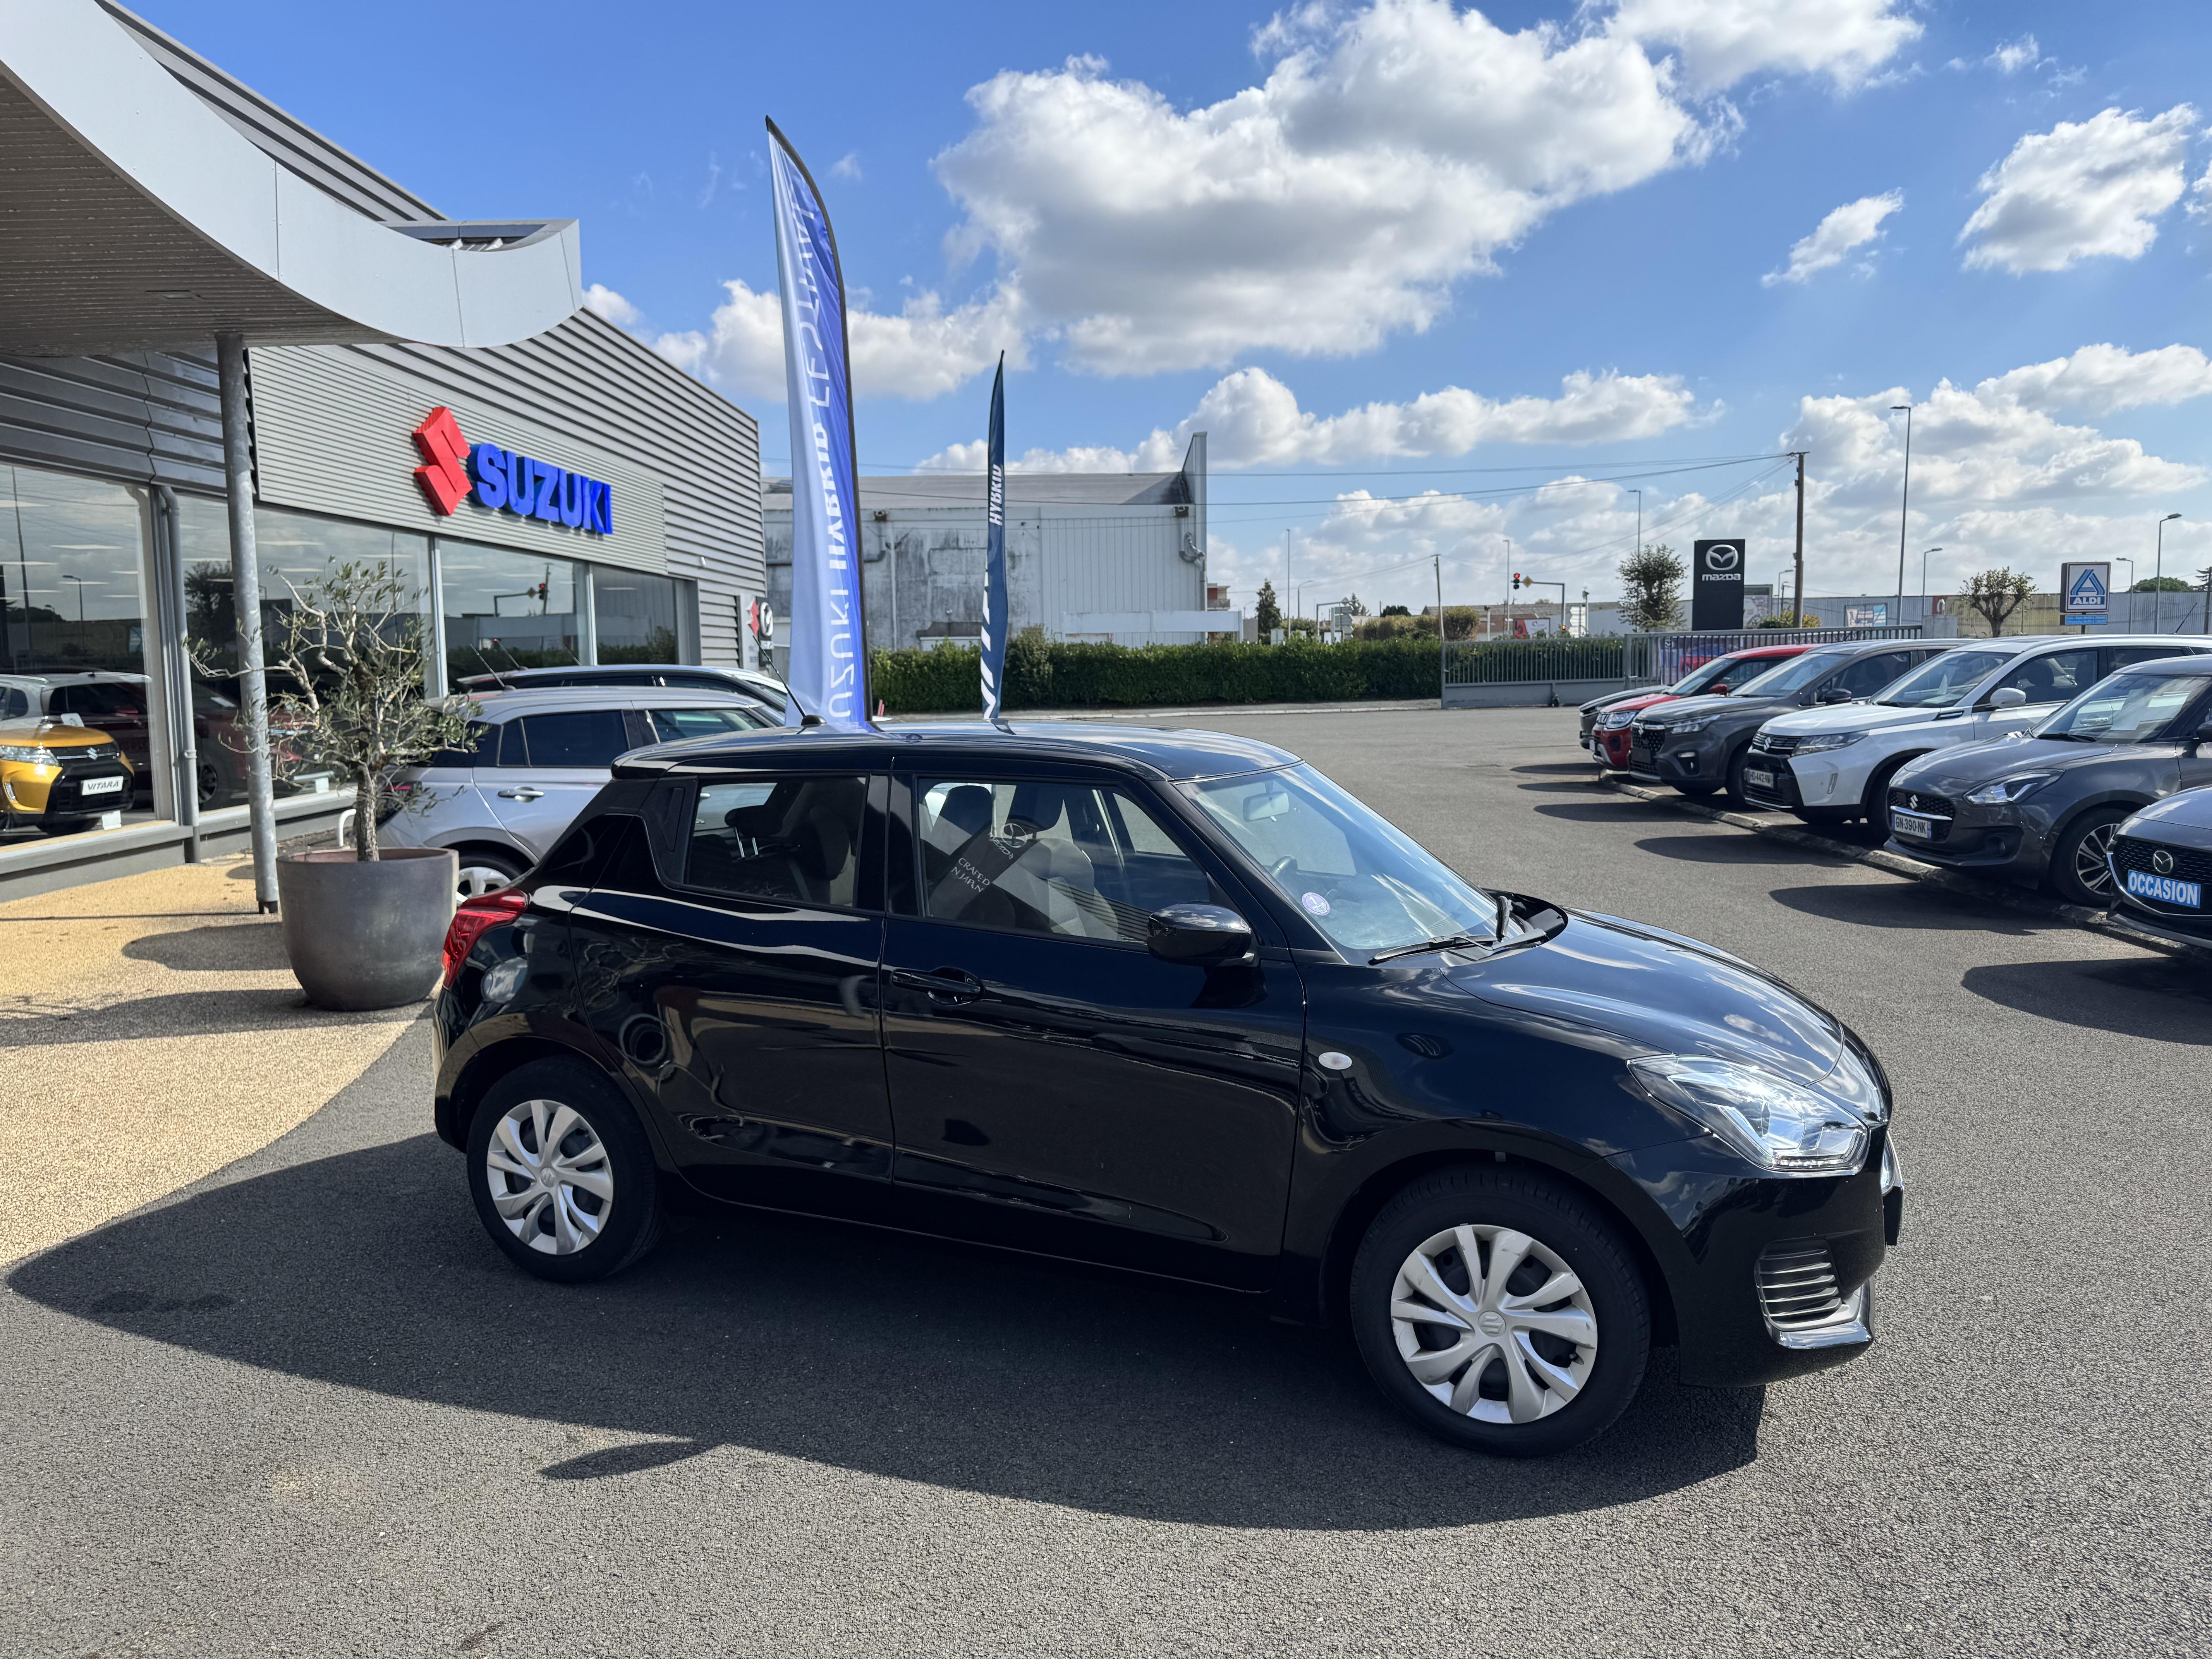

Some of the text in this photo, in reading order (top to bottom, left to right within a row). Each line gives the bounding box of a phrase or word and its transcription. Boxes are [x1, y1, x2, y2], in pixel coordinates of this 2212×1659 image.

[466, 443, 613, 535] SUZUKI
[88, 780, 118, 790] VITARA
[1896, 816, 1926, 834] GN-390-NK
[959, 873, 984, 892] JAPAN
[2129, 872, 2198, 905] OCCASION
[1309, 896, 1317, 905] 1
